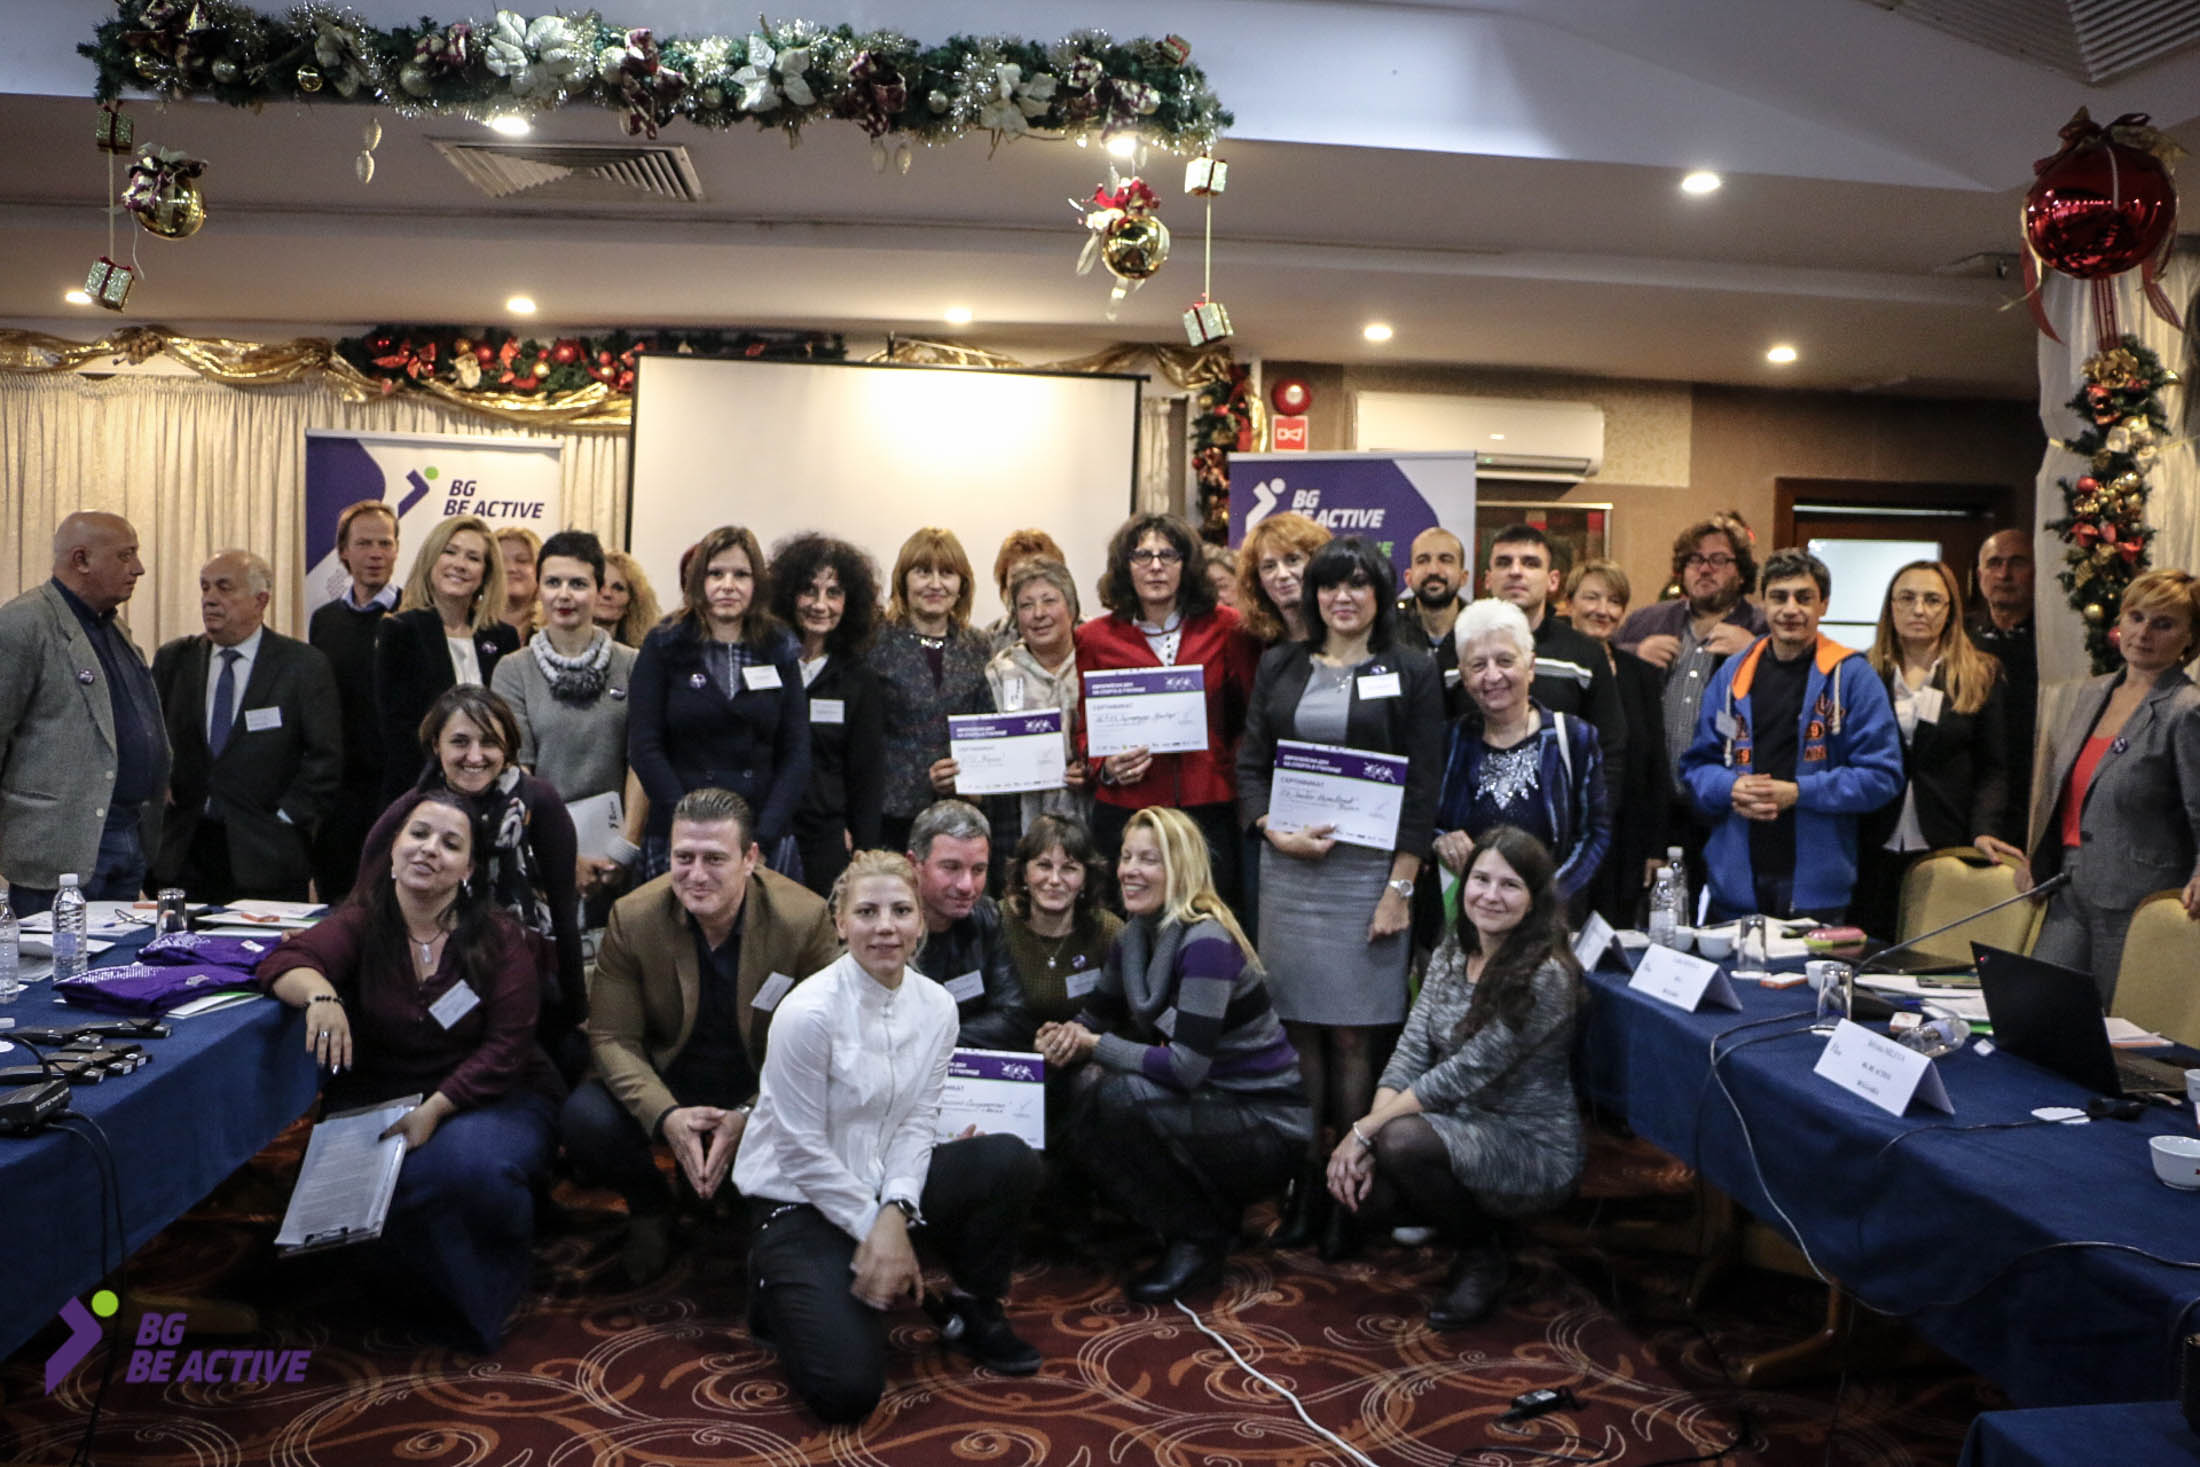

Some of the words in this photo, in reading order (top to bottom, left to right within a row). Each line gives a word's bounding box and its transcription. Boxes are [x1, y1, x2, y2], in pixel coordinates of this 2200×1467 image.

[449, 479, 477, 496] BG
[1291, 489, 1321, 508] BG
[443, 499, 471, 516] BE
[473, 500, 545, 519] ACTIVE
[1316, 508, 1385, 528] ACTIVE
